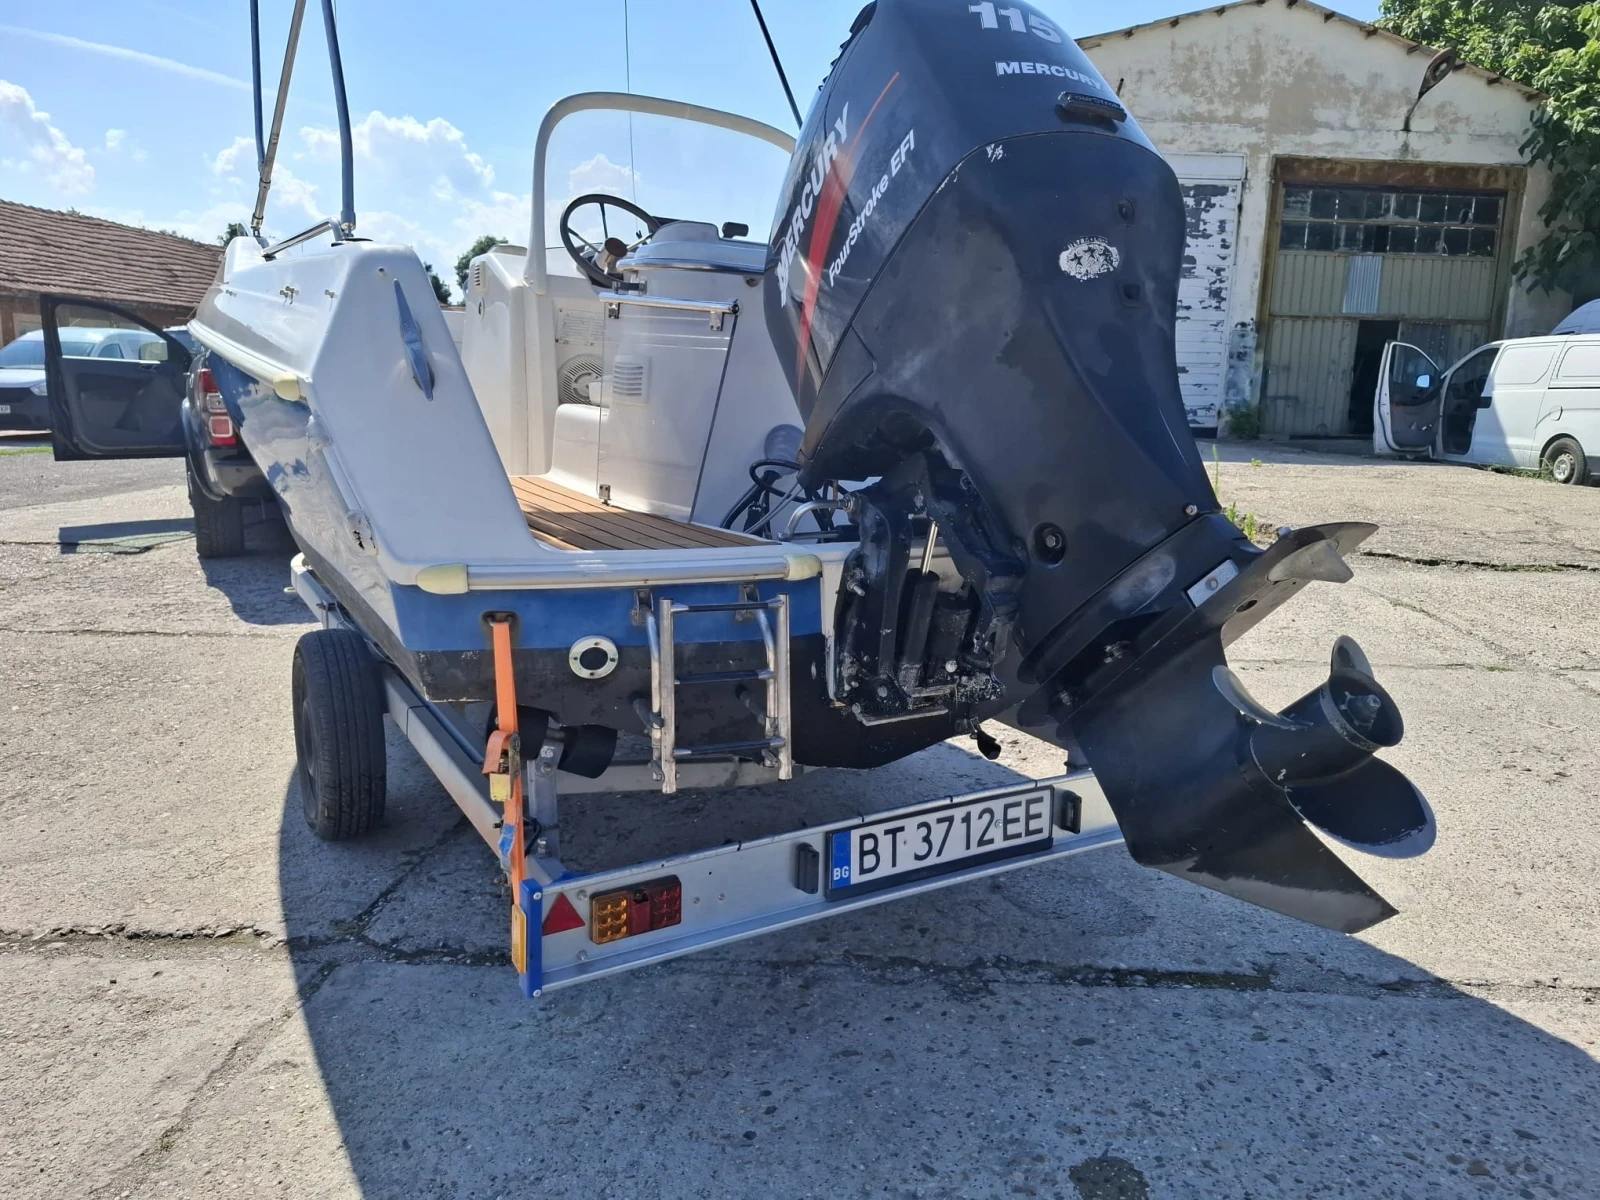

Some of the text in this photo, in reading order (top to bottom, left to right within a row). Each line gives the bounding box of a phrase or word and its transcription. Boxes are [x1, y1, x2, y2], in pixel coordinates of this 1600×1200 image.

[968, 1, 1062, 44] 115
[995, 60, 1103, 90] MERCURY
[777, 102, 849, 308] MERCURY
[829, 129, 914, 287] FourStroke EFI
[833, 866, 849, 880] BG
